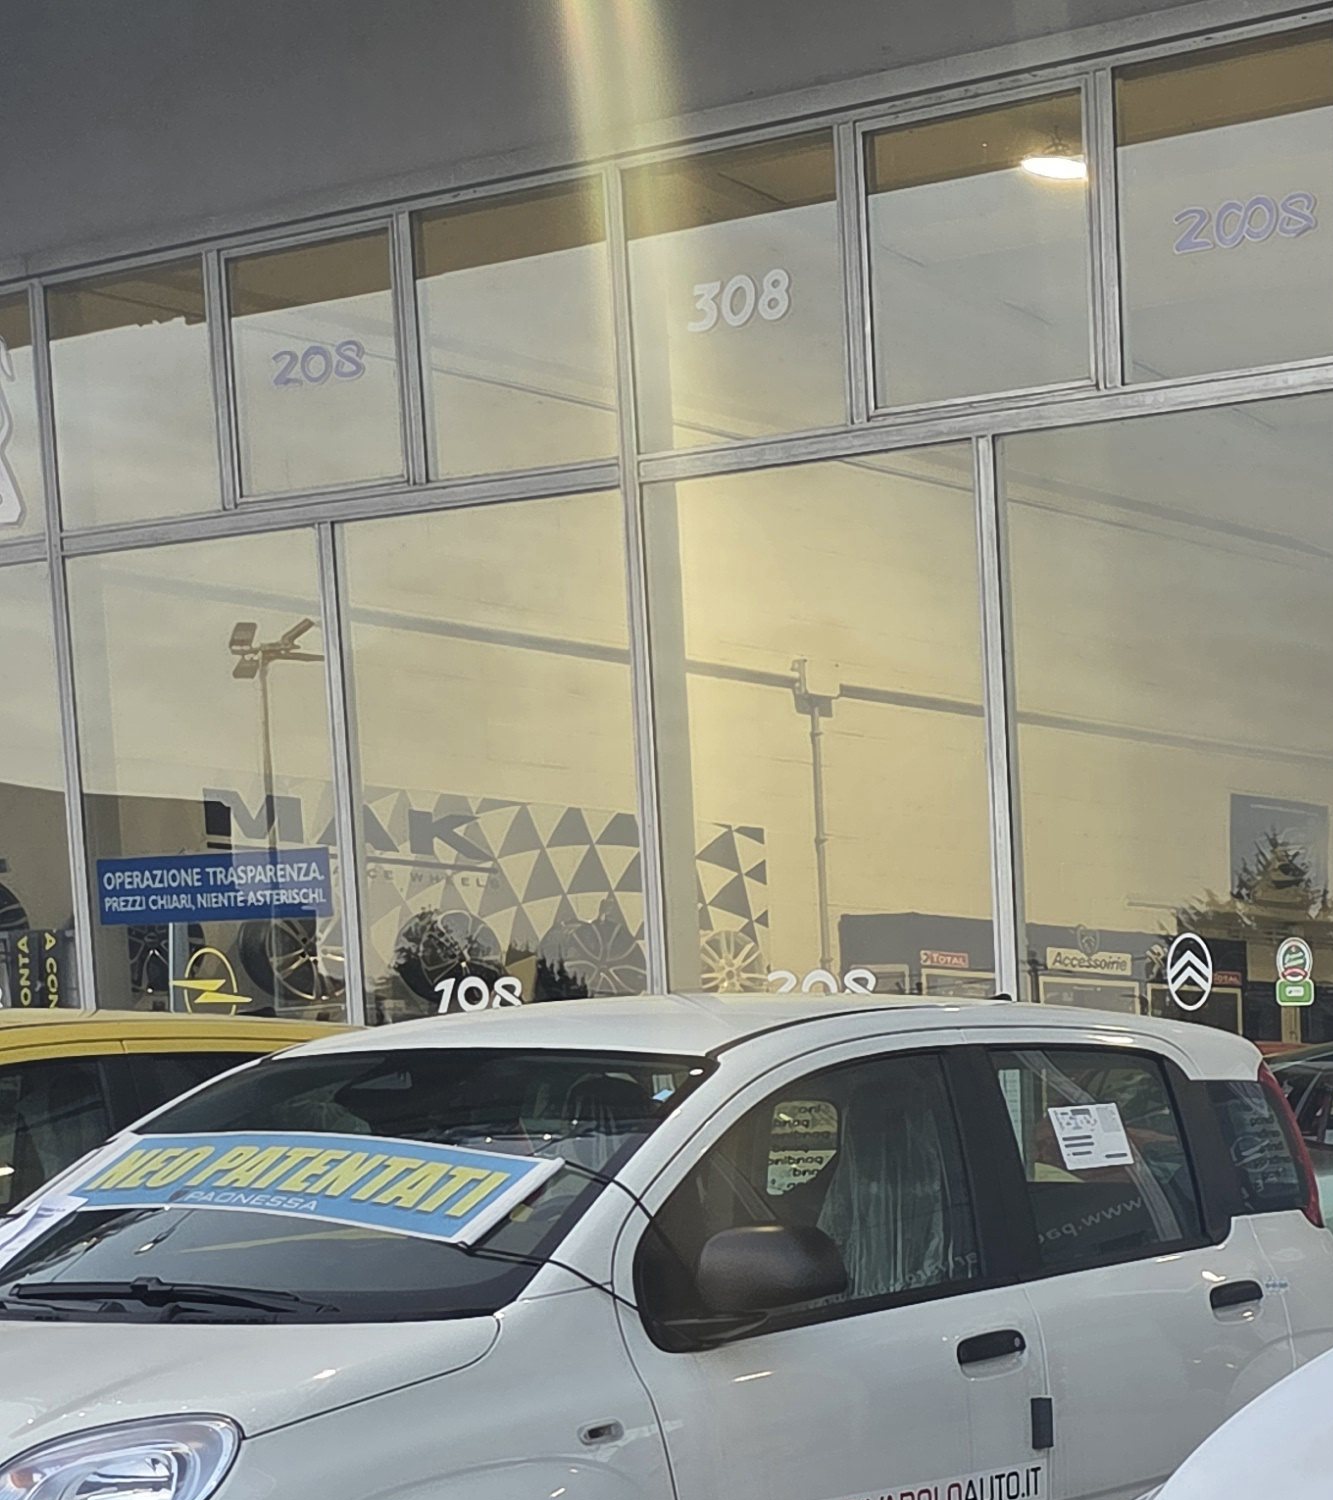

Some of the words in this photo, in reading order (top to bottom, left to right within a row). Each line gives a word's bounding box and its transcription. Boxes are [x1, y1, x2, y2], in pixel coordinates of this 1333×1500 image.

[1173, 191, 1317, 254] 2008
[687, 268, 790, 333] 308
[271, 339, 367, 387] 208
[103, 867, 202, 890] OPERAZIONE
[206, 861, 325, 886] TRASPARENZA.
[104, 895, 146, 912] PREZZI
[197, 892, 245, 909] NIENTE
[433, 975, 523, 1014] 108
[89, 1144, 215, 1191] NEO
[187, 1145, 510, 1218] PATENTATI
[185, 1189, 319, 1213] PAONESSA
